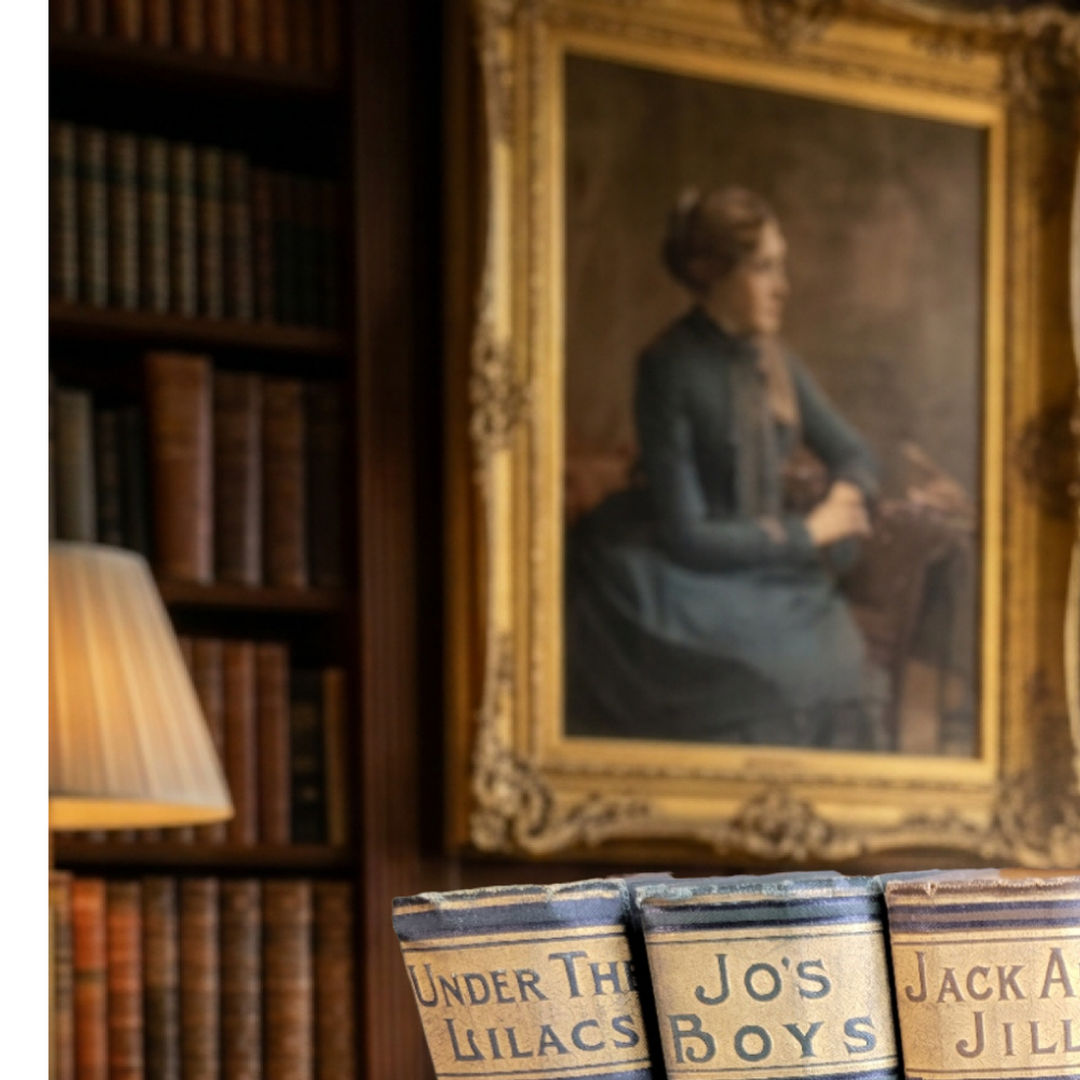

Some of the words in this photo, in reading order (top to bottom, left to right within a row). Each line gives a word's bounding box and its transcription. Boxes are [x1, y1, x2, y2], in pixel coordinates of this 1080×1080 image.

[408, 963, 549, 1007] UNDER
[695, 953, 831, 1005] JO'S
[904, 951, 1027, 1003] JACK
[444, 1015, 640, 1062] LILACS
[668, 1013, 877, 1064] BOYS
